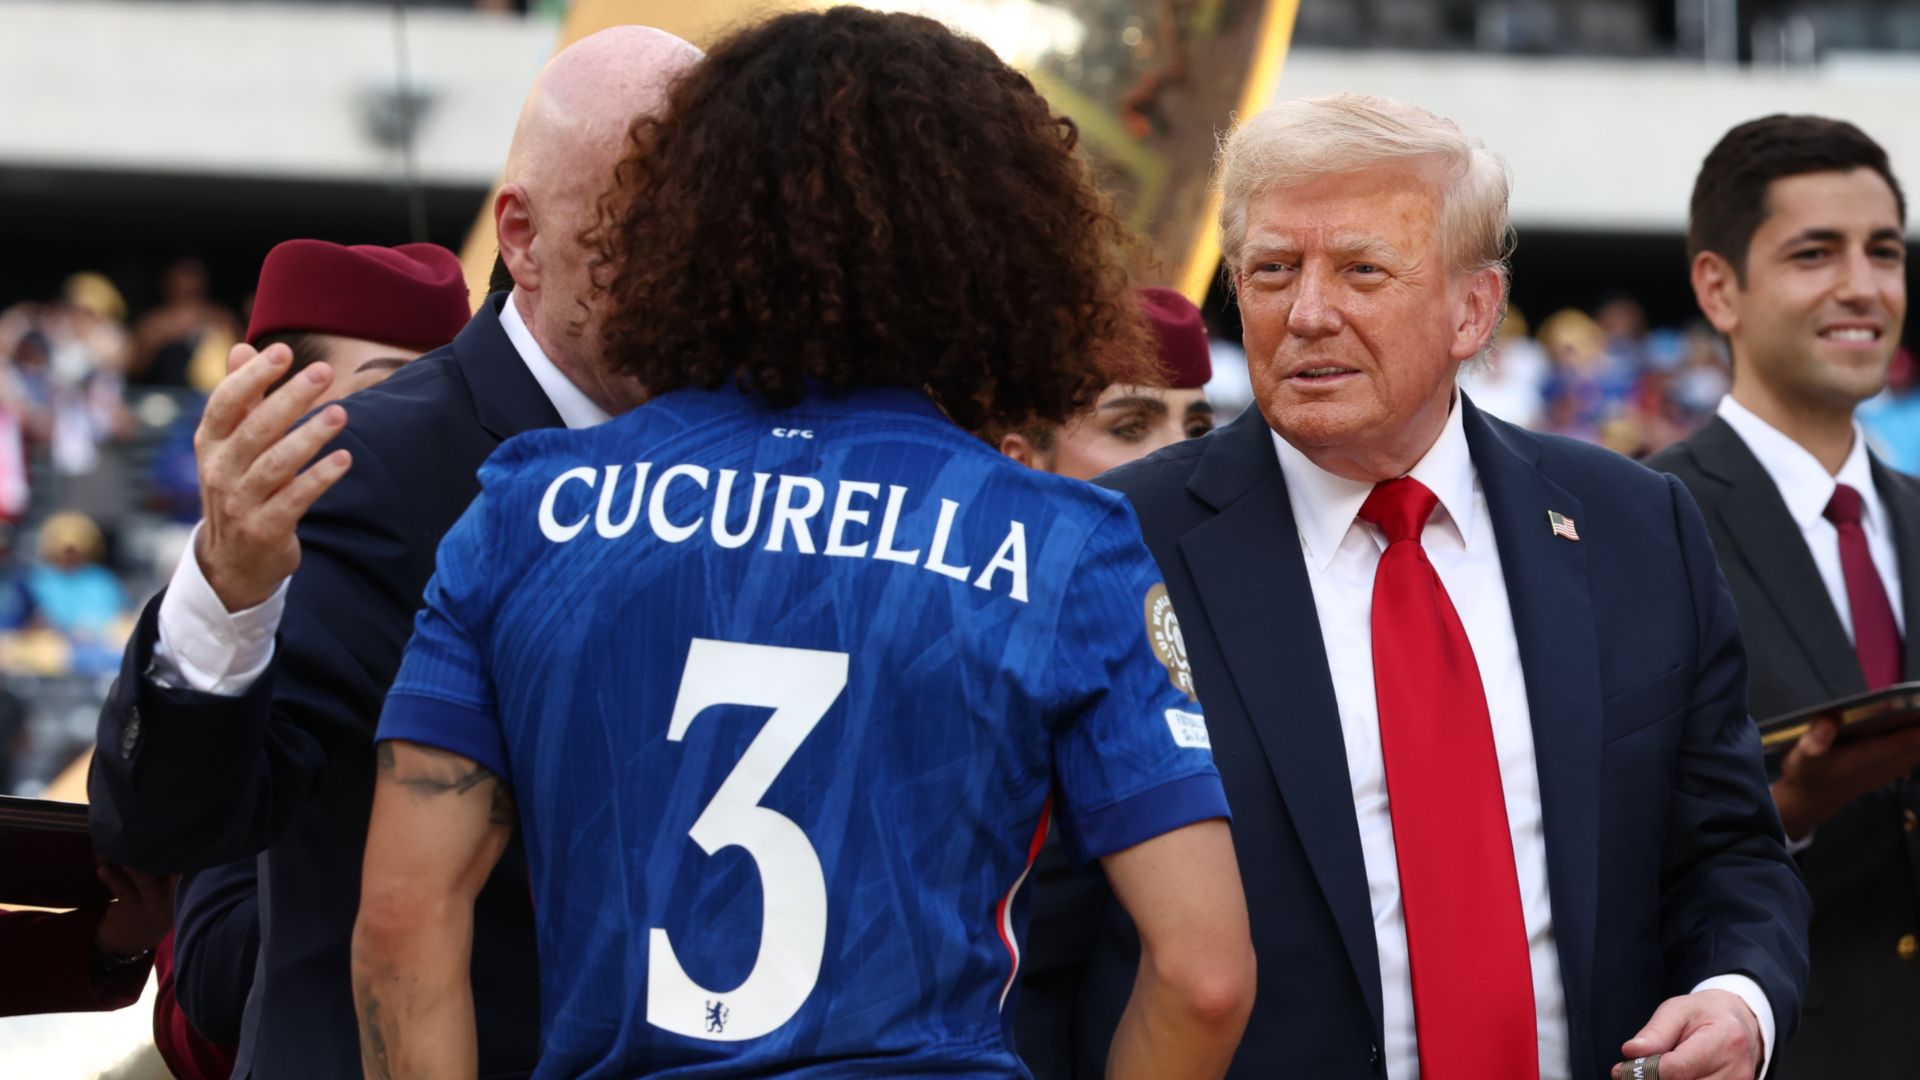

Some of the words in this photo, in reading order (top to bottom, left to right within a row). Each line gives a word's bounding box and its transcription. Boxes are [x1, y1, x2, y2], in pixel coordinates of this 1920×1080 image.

[771, 427, 814, 439] CFC
[538, 462, 1029, 603] CUCURELLA
[646, 638, 849, 1042] 3
